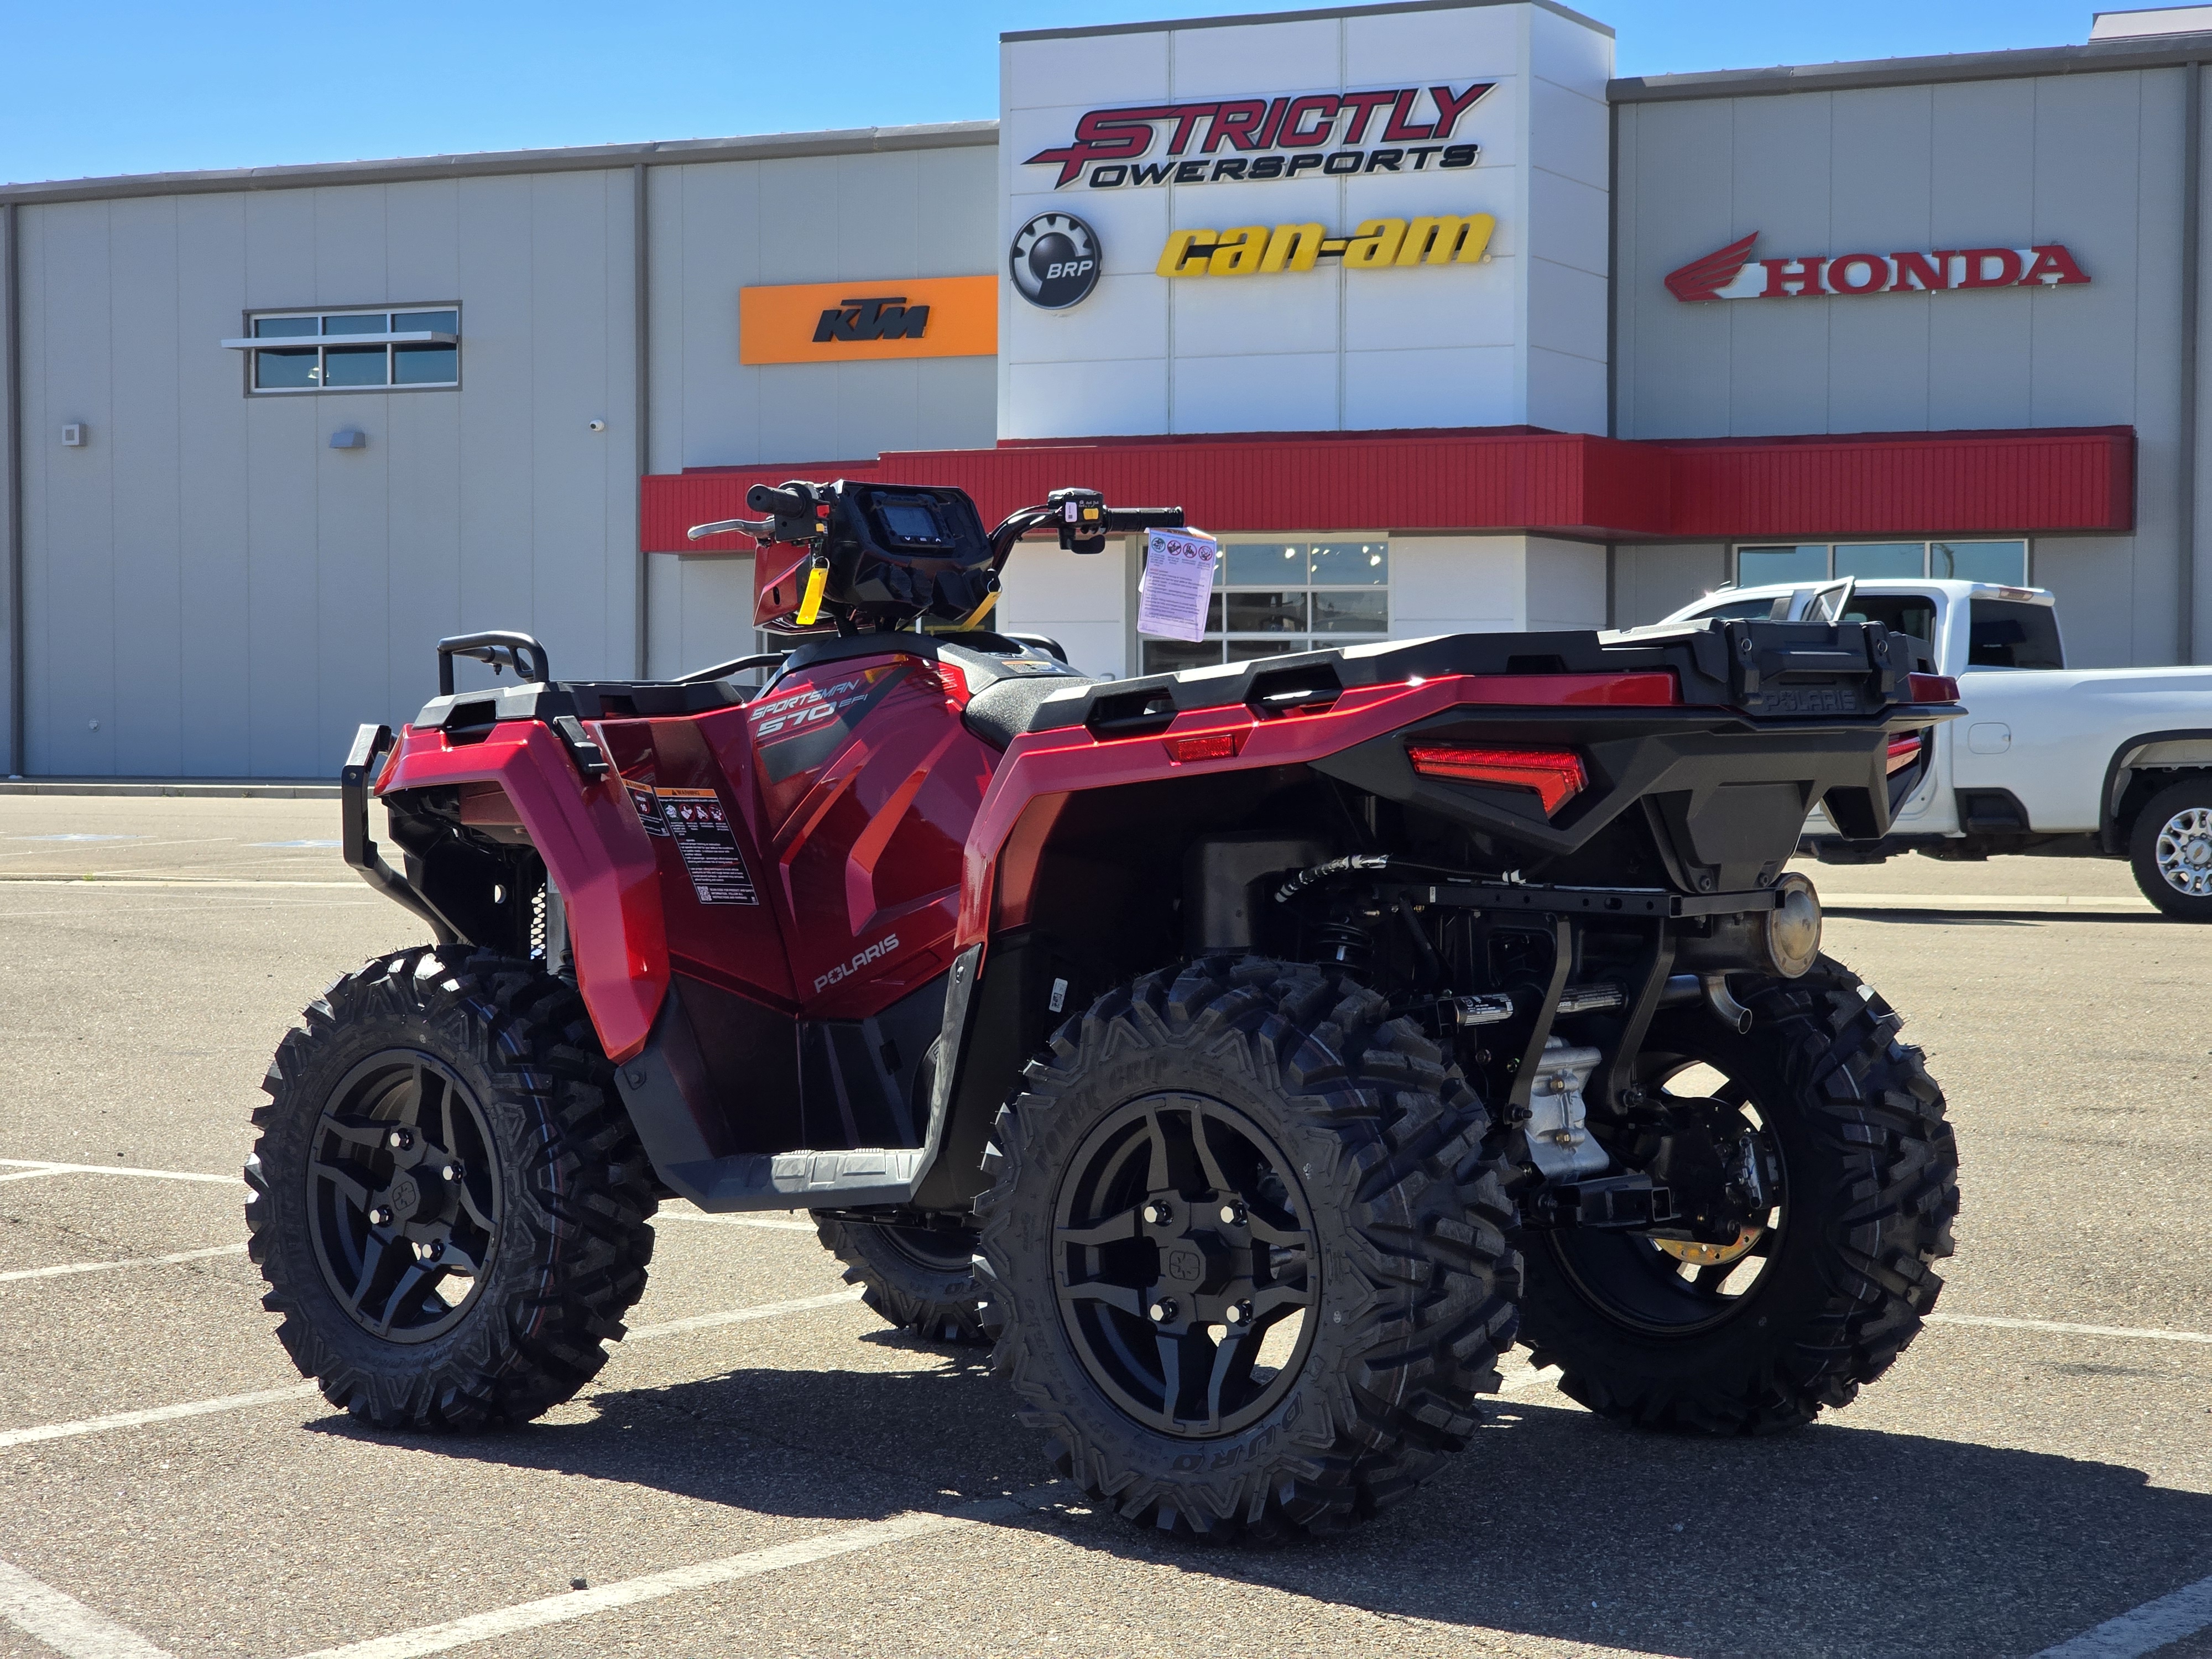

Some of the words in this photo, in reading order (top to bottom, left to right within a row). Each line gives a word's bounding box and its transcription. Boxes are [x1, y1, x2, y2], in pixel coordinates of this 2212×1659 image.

[1022, 83, 1498, 166] STRICTLY
[1045, 259, 1093, 279] BRP
[1759, 244, 2091, 298] HONDA
[812, 297, 930, 342] KTM
[749, 679, 859, 721] SPORTSMAN
[756, 701, 837, 737] 570
[838, 693, 868, 708] EFI
[1763, 690, 1857, 711] POLARIS
[813, 933, 900, 994] POLARIS
[1170, 1391, 1303, 1472] DURO
